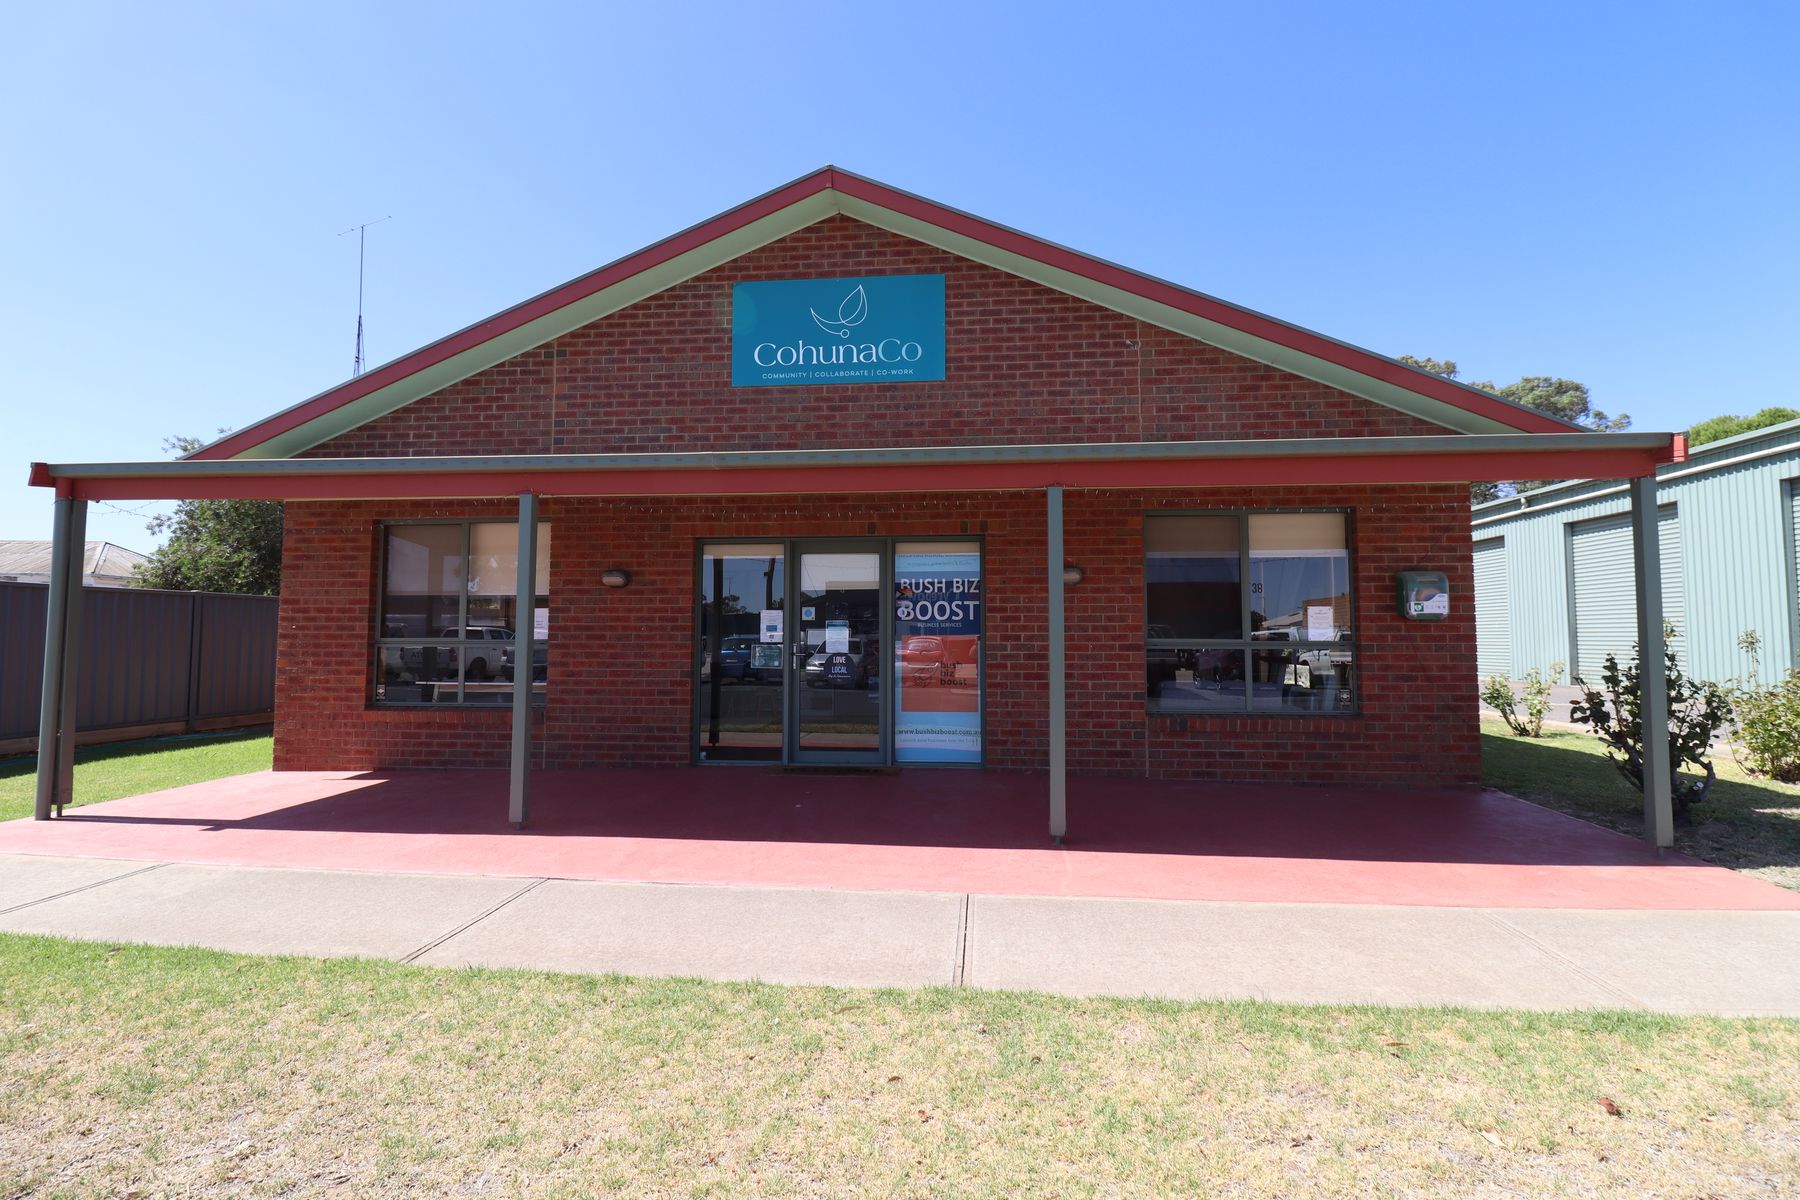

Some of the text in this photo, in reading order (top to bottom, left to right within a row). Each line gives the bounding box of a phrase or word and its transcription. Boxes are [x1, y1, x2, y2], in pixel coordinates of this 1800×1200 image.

[754, 338, 922, 367] CohunaCo
[814, 370, 869, 378] COLLABORATE
[877, 368, 914, 376] CO-WORK
[900, 578, 979, 593] BUSH BIZ
[1251, 582, 1263, 594] 38
[899, 600, 980, 621] BOOST
[832, 656, 847, 664] LOVE
[940, 678, 967, 686] boost
